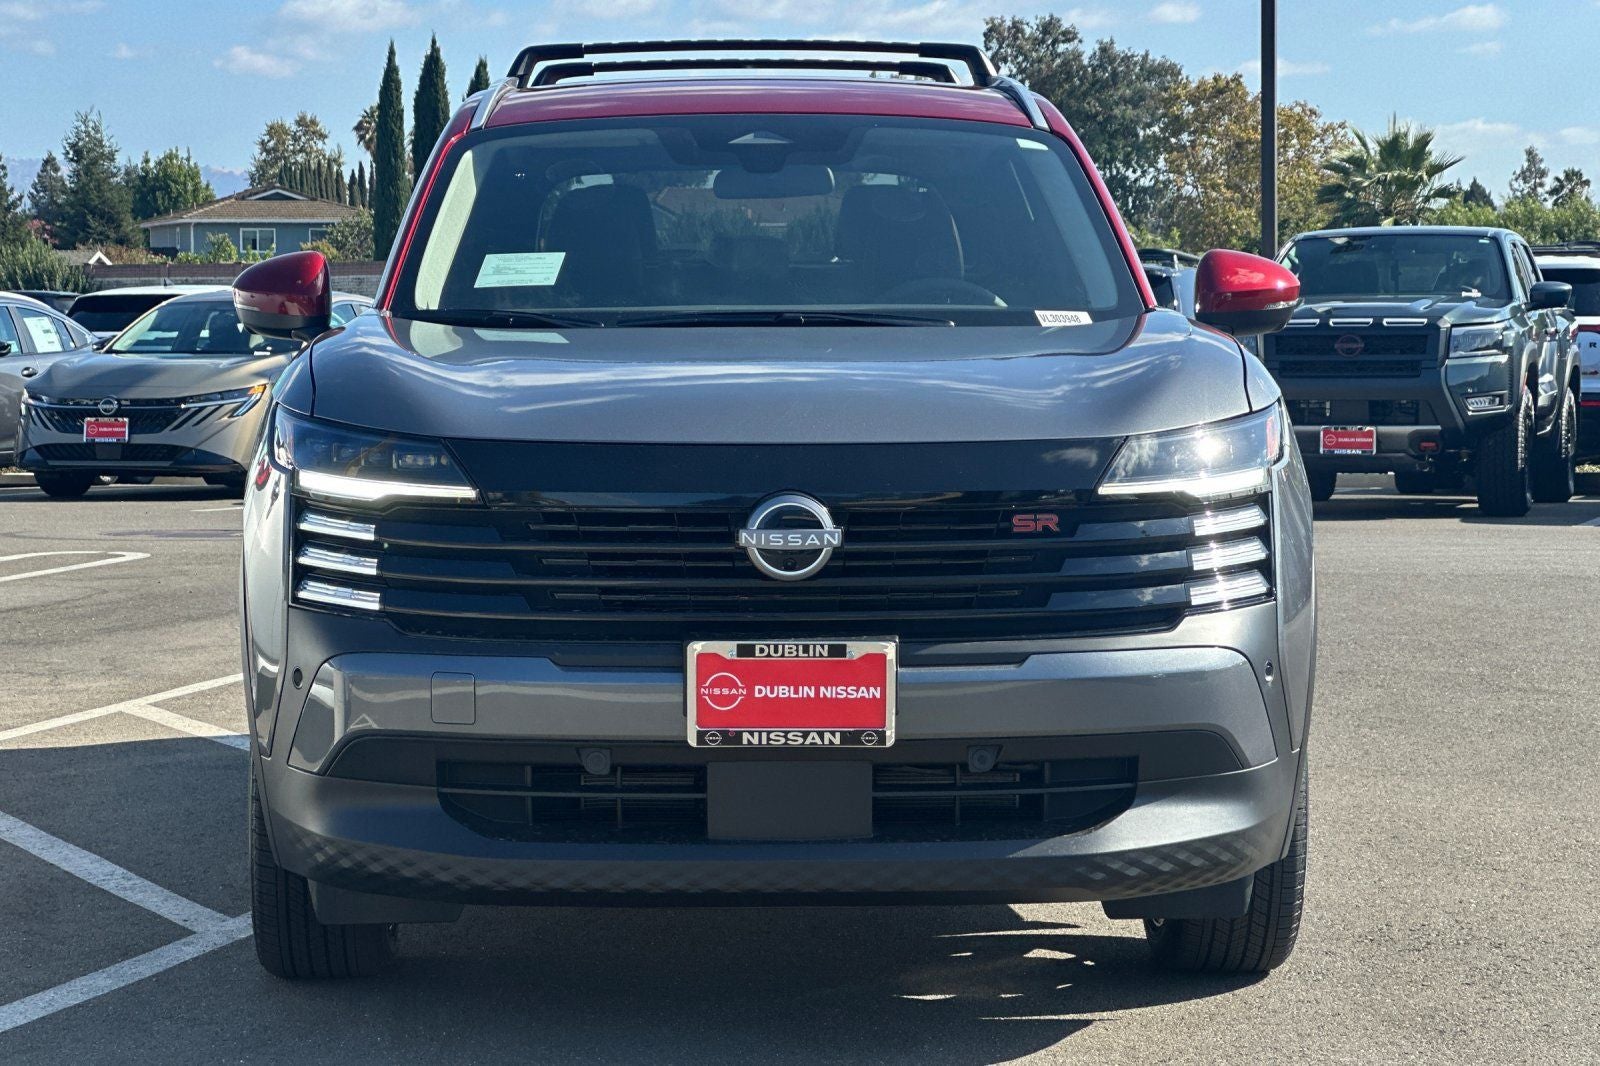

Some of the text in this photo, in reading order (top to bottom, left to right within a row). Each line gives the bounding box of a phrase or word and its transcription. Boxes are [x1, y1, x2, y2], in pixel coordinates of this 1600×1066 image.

[1039, 313, 1081, 323] VL303948
[1013, 514, 1060, 532] SR
[741, 532, 840, 546] NISSAN
[755, 644, 829, 657] DUBLIN
[701, 687, 747, 695] NISSAN
[754, 685, 881, 699] DUBLIN NISSAN
[742, 731, 841, 745] NISSAN
